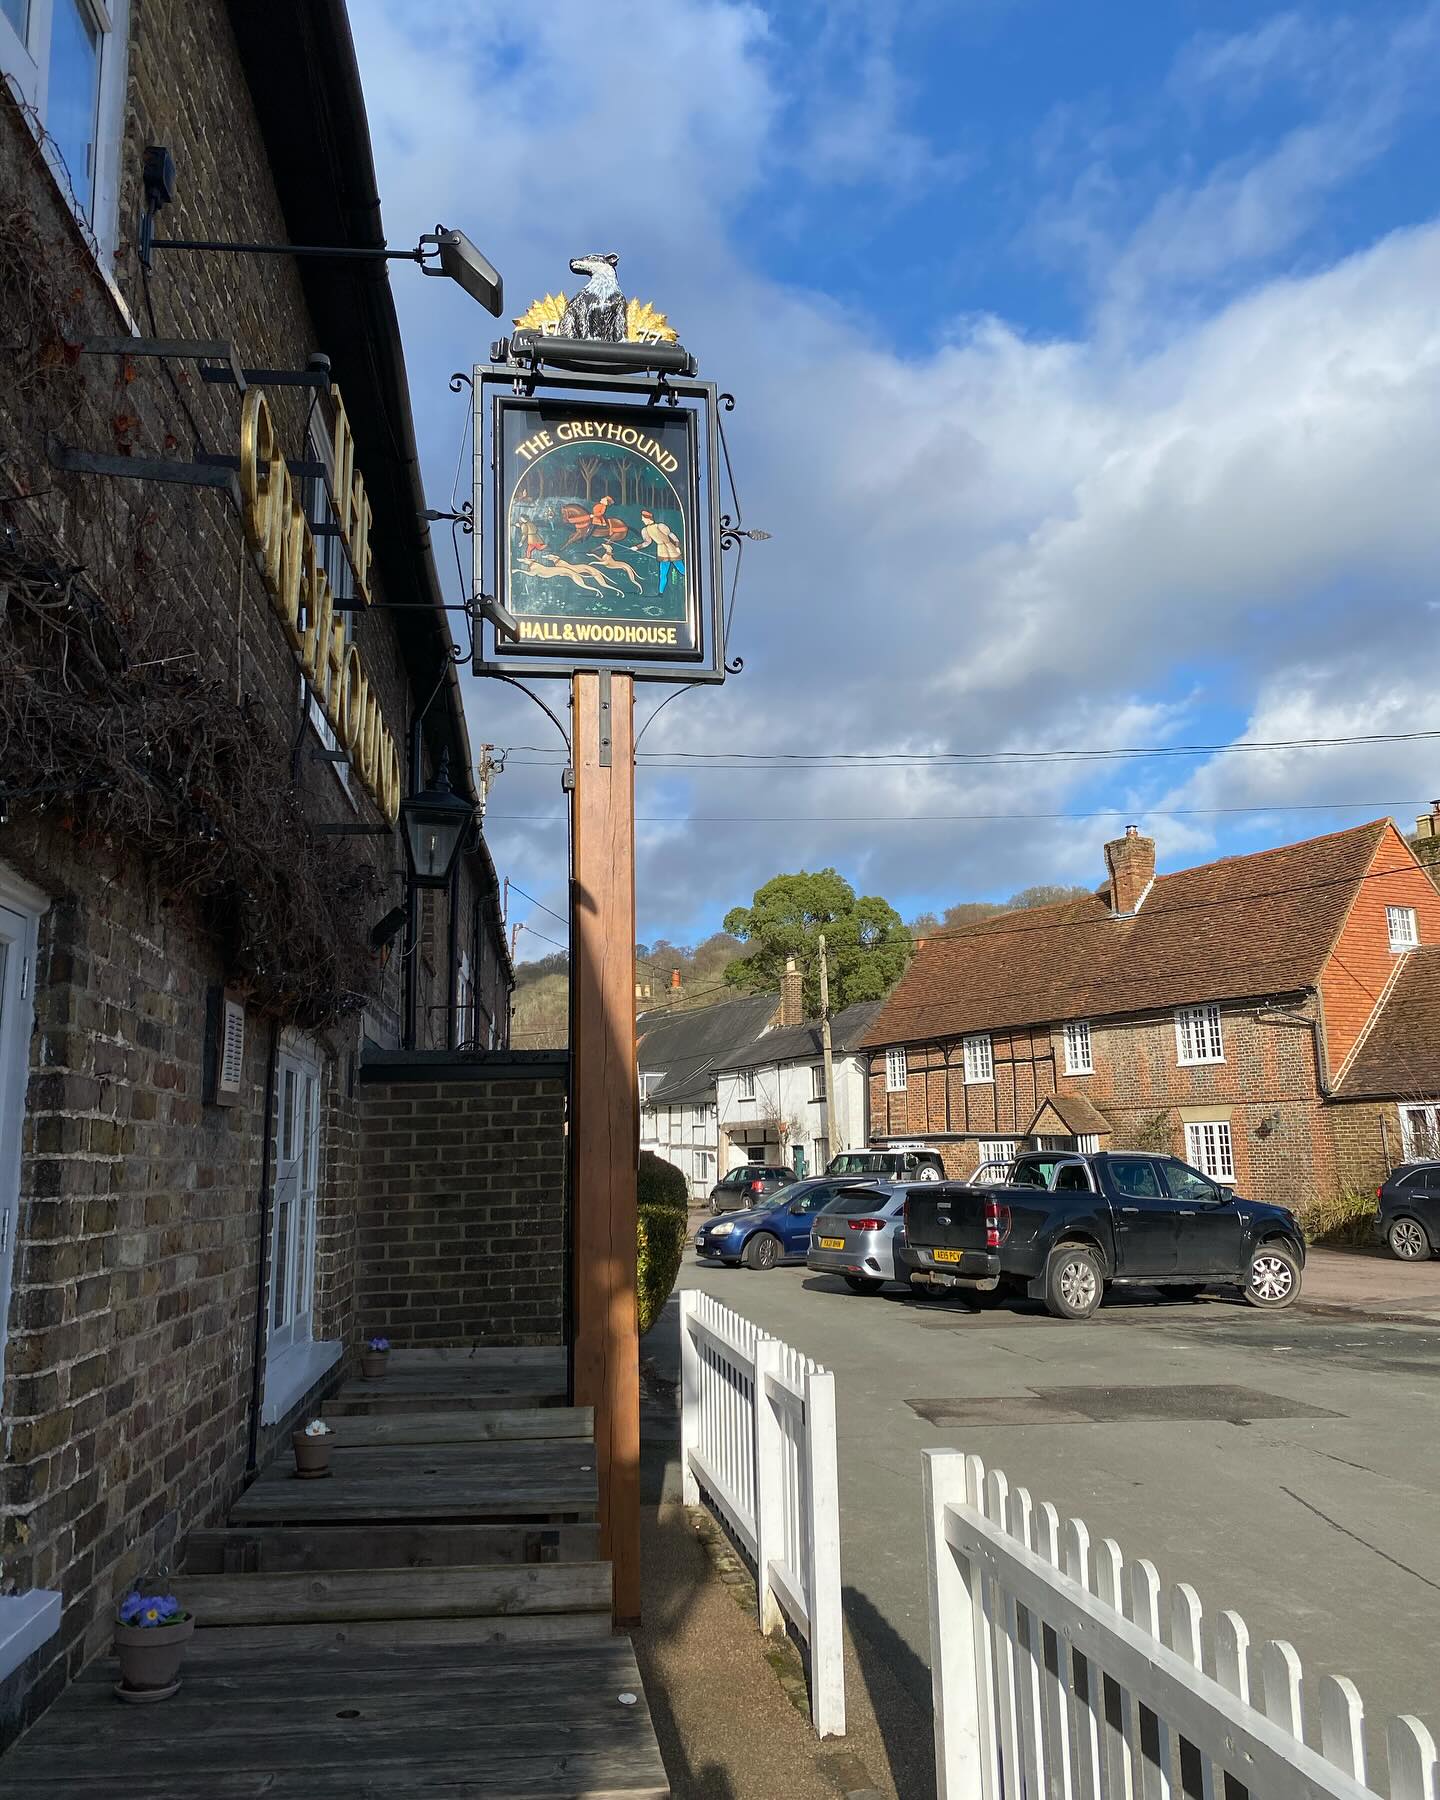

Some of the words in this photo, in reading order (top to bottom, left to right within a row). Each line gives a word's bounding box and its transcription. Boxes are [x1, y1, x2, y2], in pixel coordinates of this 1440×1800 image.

[541, 320, 560, 336] 17
[638, 329, 662, 345] 77
[515, 430, 555, 460] THE
[556, 421, 679, 472] GREYHOUND
